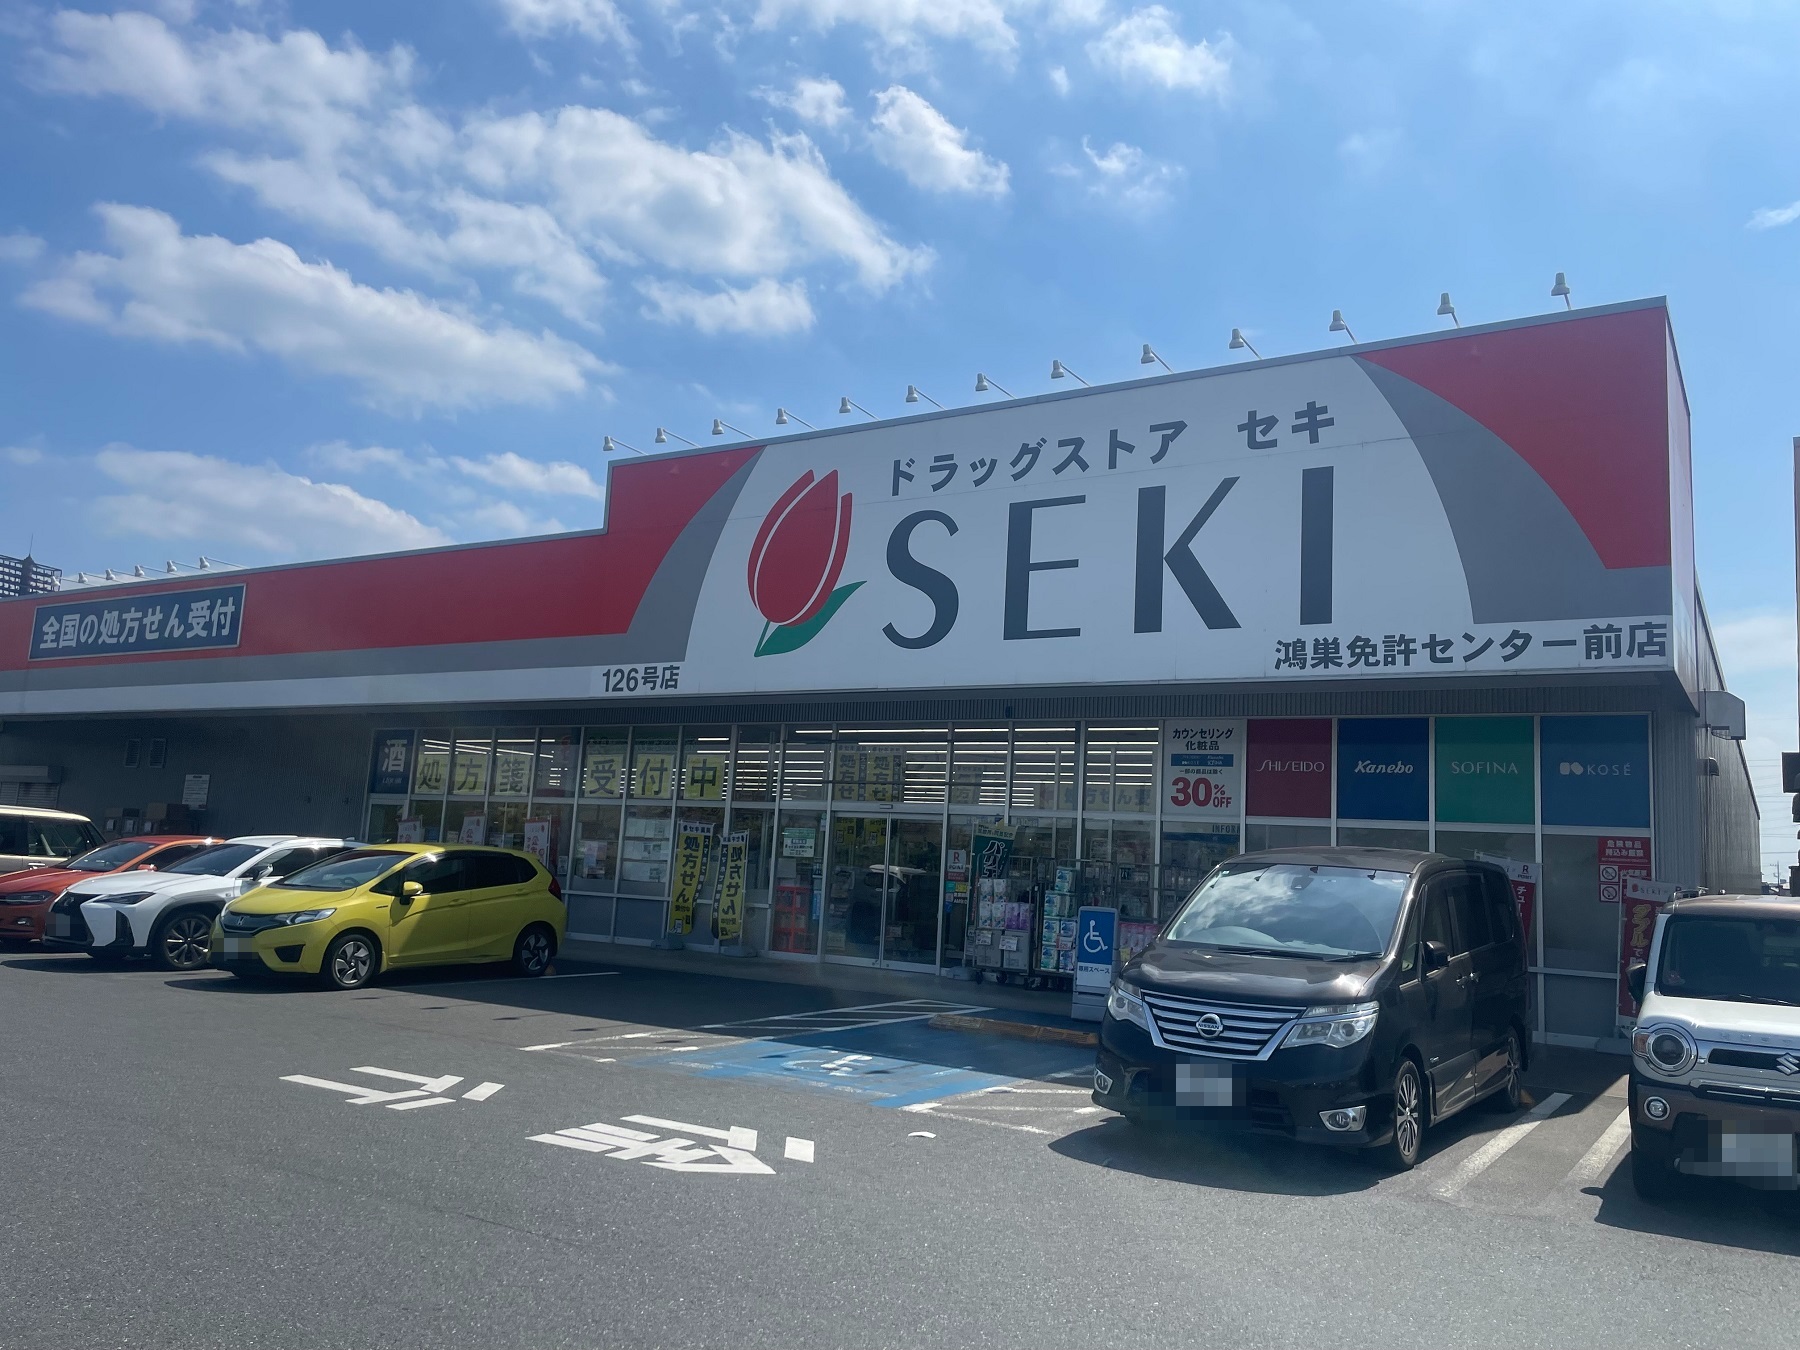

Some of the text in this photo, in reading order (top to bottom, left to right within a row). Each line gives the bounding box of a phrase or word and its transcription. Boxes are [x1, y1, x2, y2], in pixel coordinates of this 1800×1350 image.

[892, 400, 1335, 496] ドラッグストア セキ
[881, 465, 1335, 650] SEKI
[39, 596, 236, 650] 全国の処方せん受付
[1274, 621, 1668, 671] 鴻巣免許センター前店
[602, 664, 680, 692] 126号店
[1172, 728, 1235, 739] カウンセリング
[382, 739, 408, 772] 酒
[1185, 740, 1220, 751] 化粧品
[1256, 759, 1325, 772] SHISEIDO
[1354, 760, 1414, 775] Kanebo
[1451, 761, 1519, 775] SOFINA
[1587, 763, 1632, 776] KOSÉ
[1213, 797, 1232, 808] OFF
[676, 836, 700, 904] 処方せん
